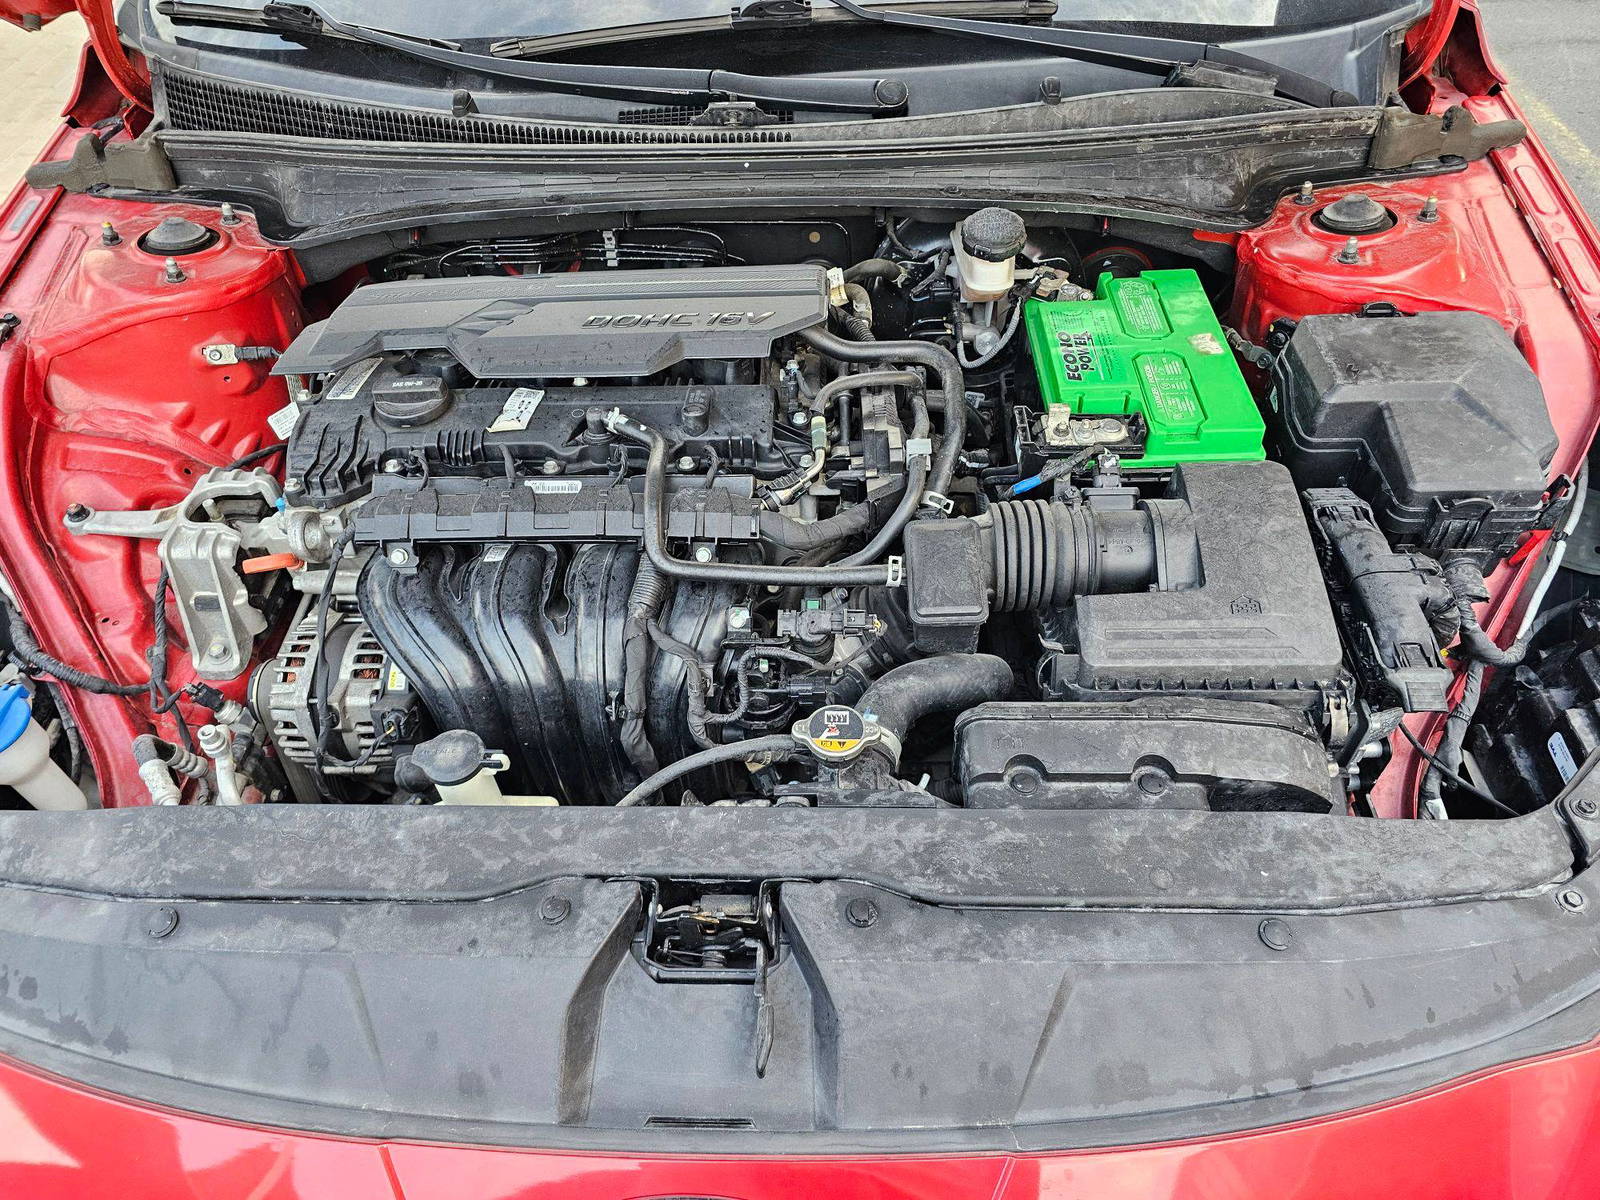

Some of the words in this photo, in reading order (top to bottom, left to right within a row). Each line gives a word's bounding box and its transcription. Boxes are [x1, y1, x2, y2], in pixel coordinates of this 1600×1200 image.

[582, 312, 699, 329] DOHC
[706, 311, 776, 326] 16V
[1057, 331, 1083, 381] ECONO
[1072, 331, 1095, 371] POWER
